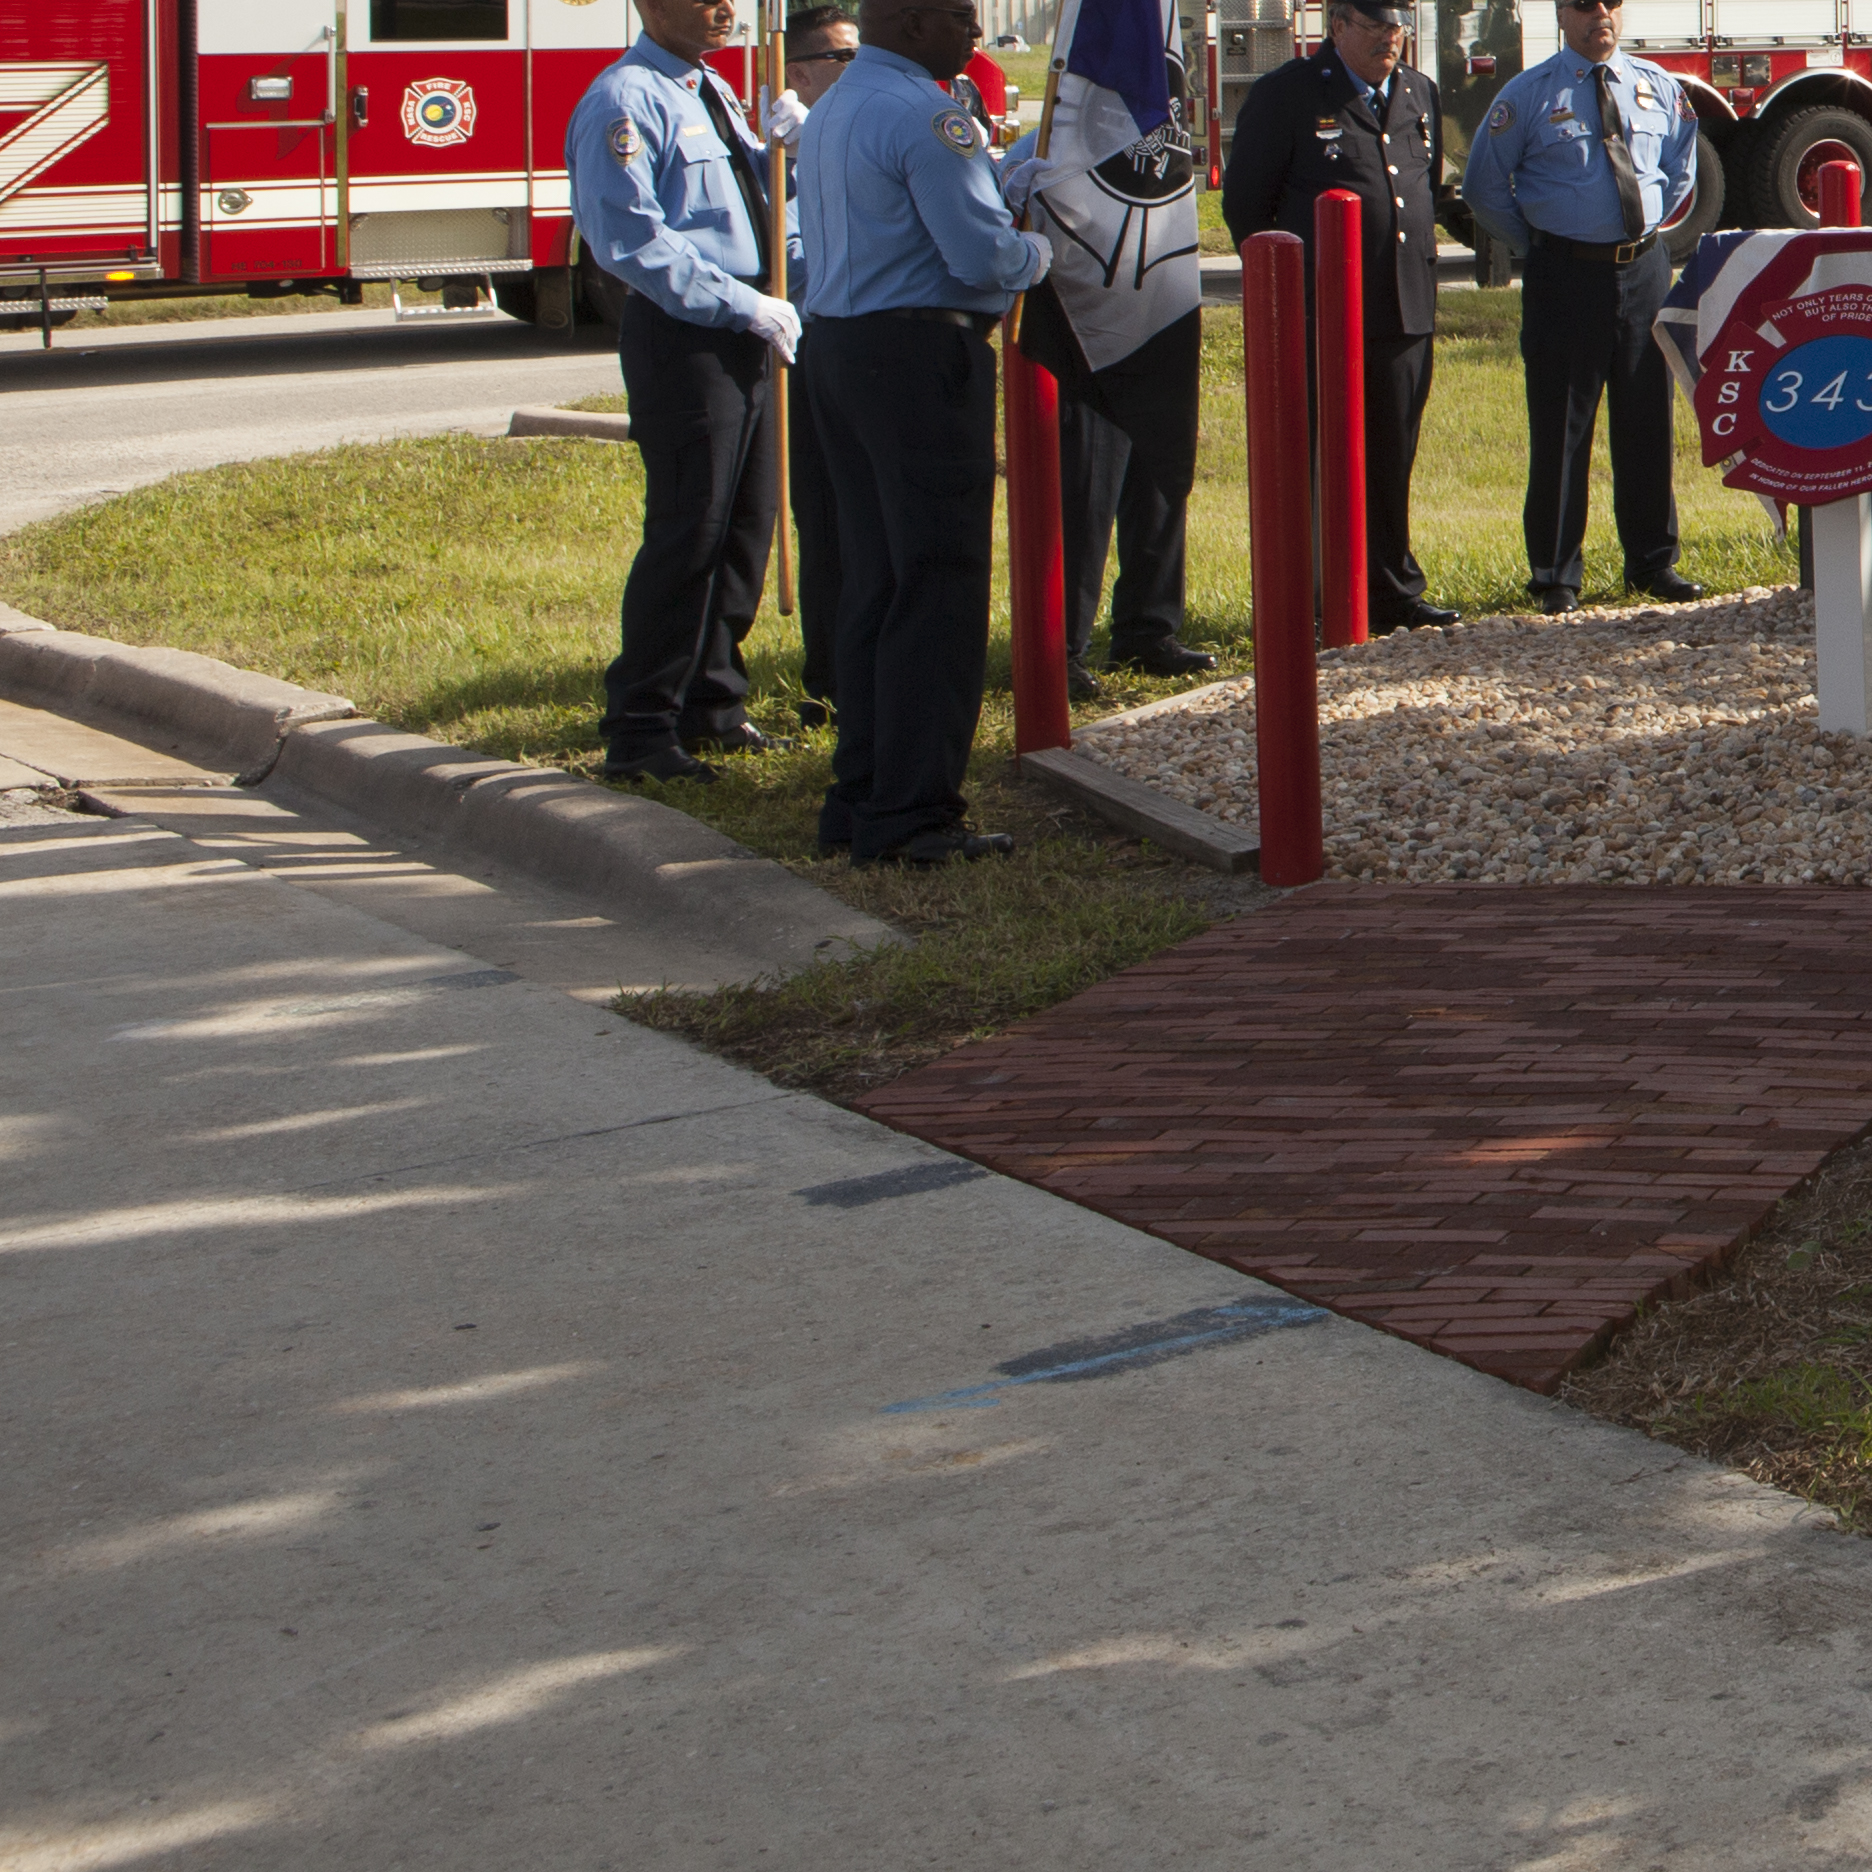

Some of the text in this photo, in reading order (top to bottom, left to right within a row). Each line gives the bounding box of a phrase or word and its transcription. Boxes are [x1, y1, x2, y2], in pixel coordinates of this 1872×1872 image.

[426, 82, 452, 91] FIRE
[406, 100, 416, 126] NASA
[463, 101, 472, 122] KSC
[420, 131, 459, 143] RESCUE
[1772, 305, 1794, 321] NOT
[1796, 296, 1826, 311] ONLY
[1829, 293, 1864, 303] TEARS
[1804, 305, 1826, 318] BUT
[1829, 302, 1858, 312] ALSO
[1822, 312, 1872, 322] OF PRIDE
[1712, 350, 1754, 436] KSC
[1750, 457, 1791, 478] DEDICATED
[1791, 471, 1802, 479] ON
[1804, 468, 1852, 480] SEPTEMBER
[1749, 472, 1759, 480] IN
[1758, 476, 1785, 489] HONOR
[1785, 483, 1798, 491] OF
[1799, 484, 1816, 492] OUR
[1818, 481, 1849, 492] FALLEN
